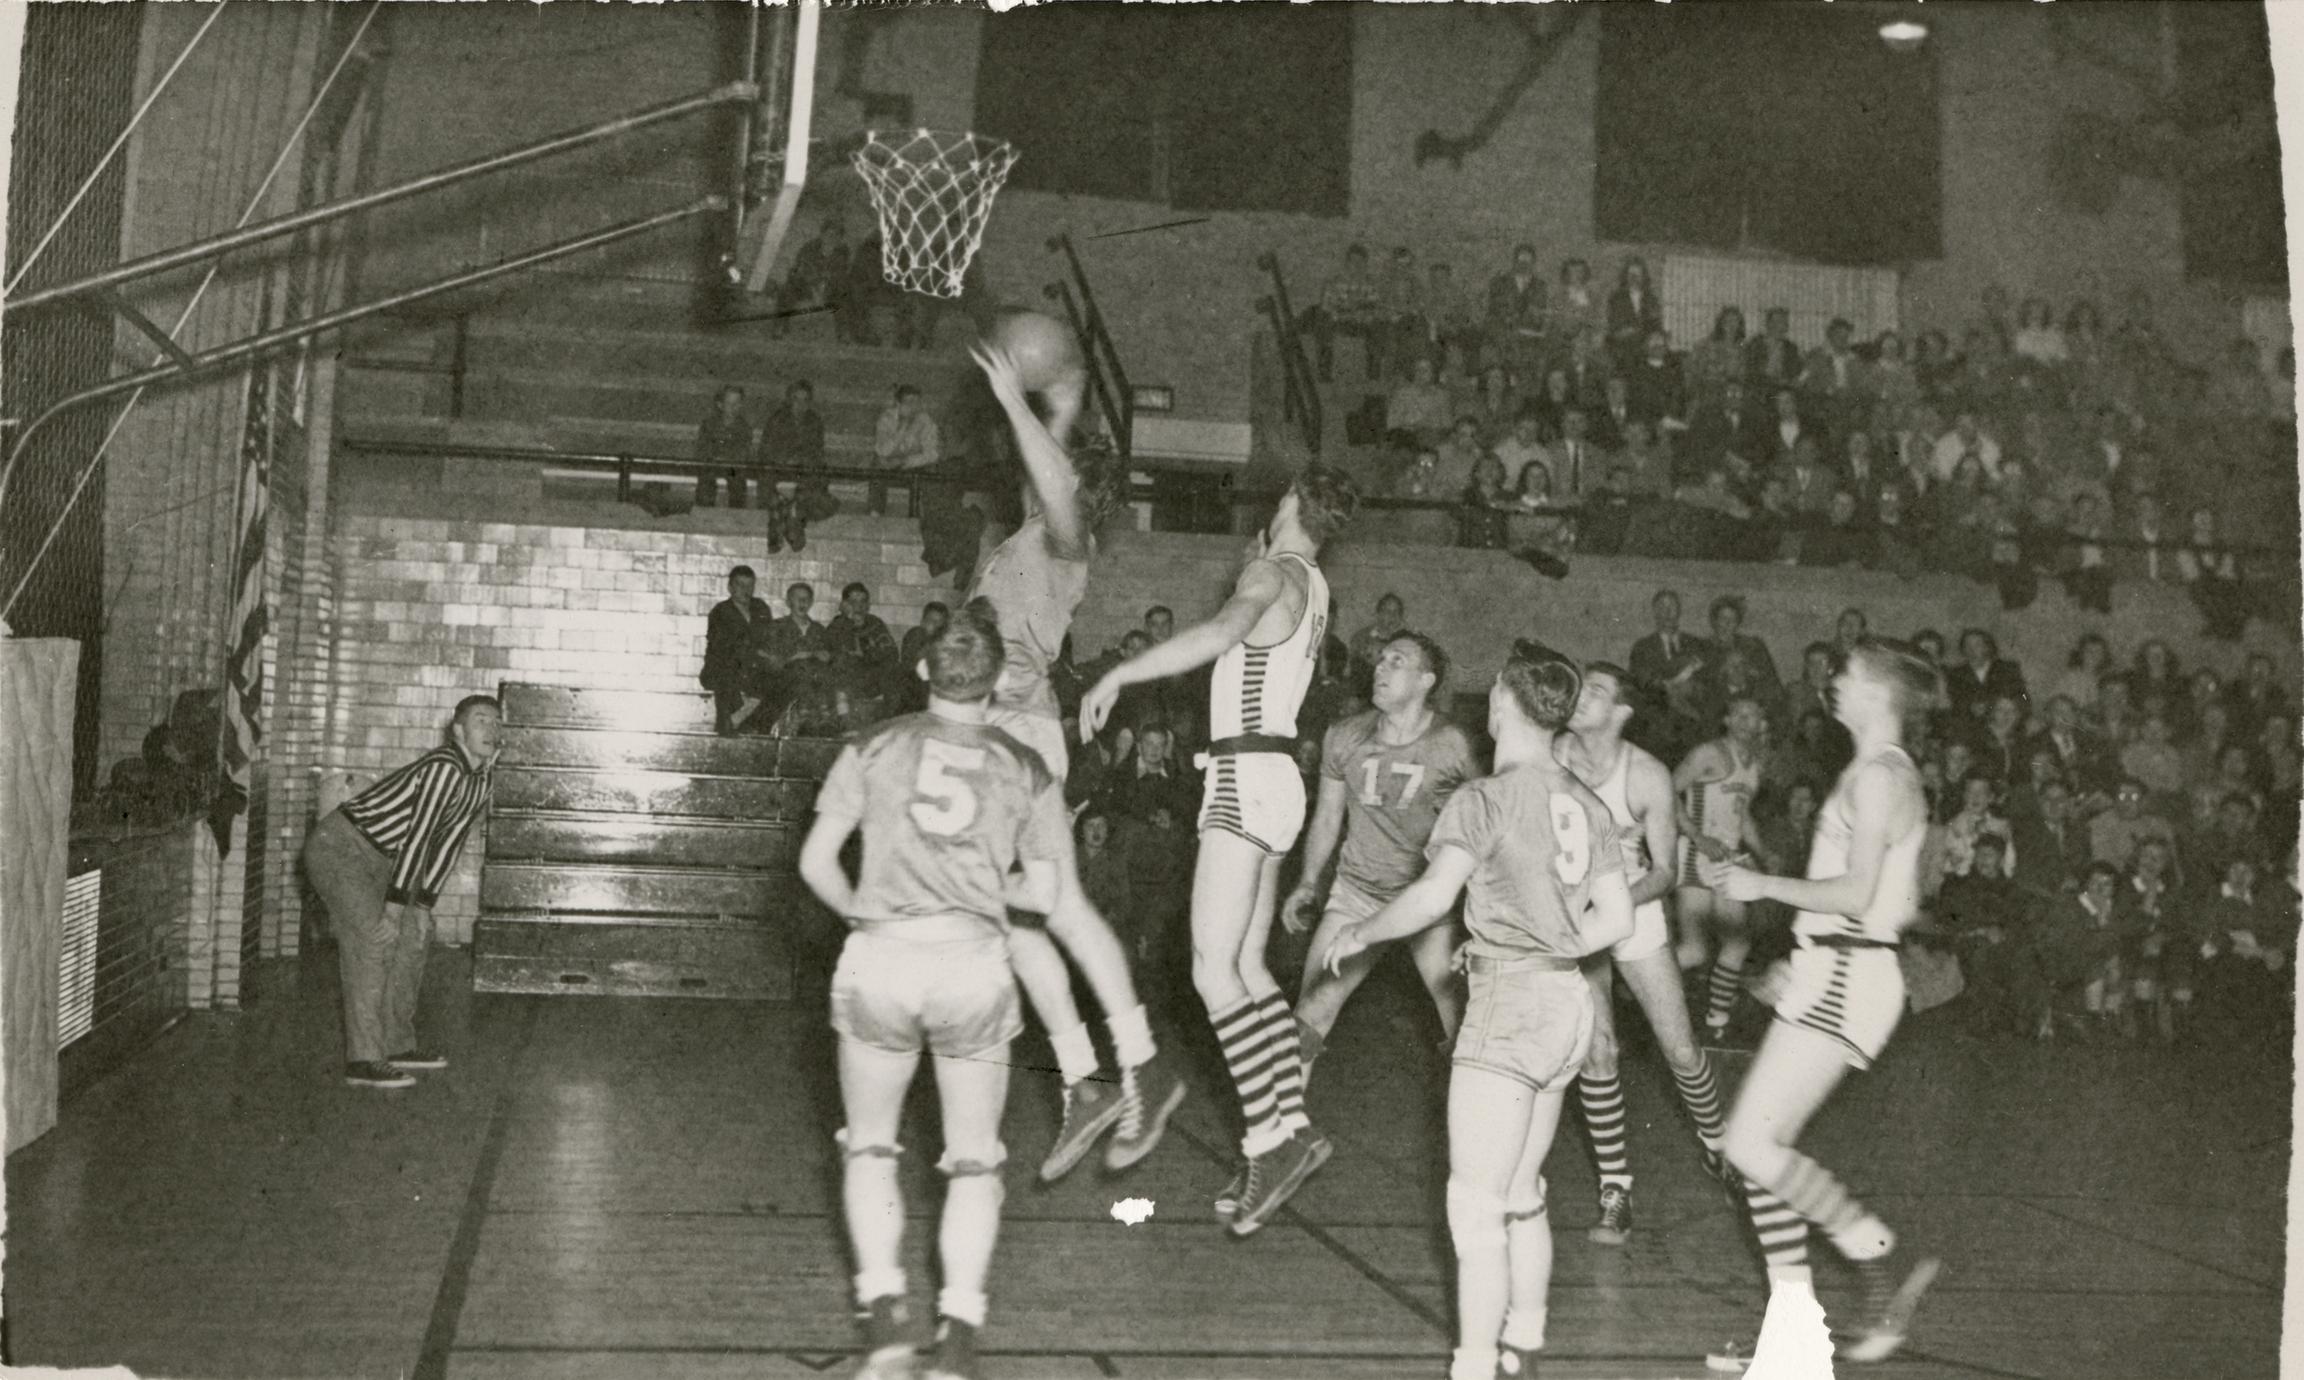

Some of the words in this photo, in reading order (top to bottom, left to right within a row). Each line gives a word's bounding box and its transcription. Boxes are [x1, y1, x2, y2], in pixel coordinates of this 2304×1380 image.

[910, 737, 985, 836] 5
[1360, 758, 1424, 809] 17
[1550, 793, 1590, 885] 9
